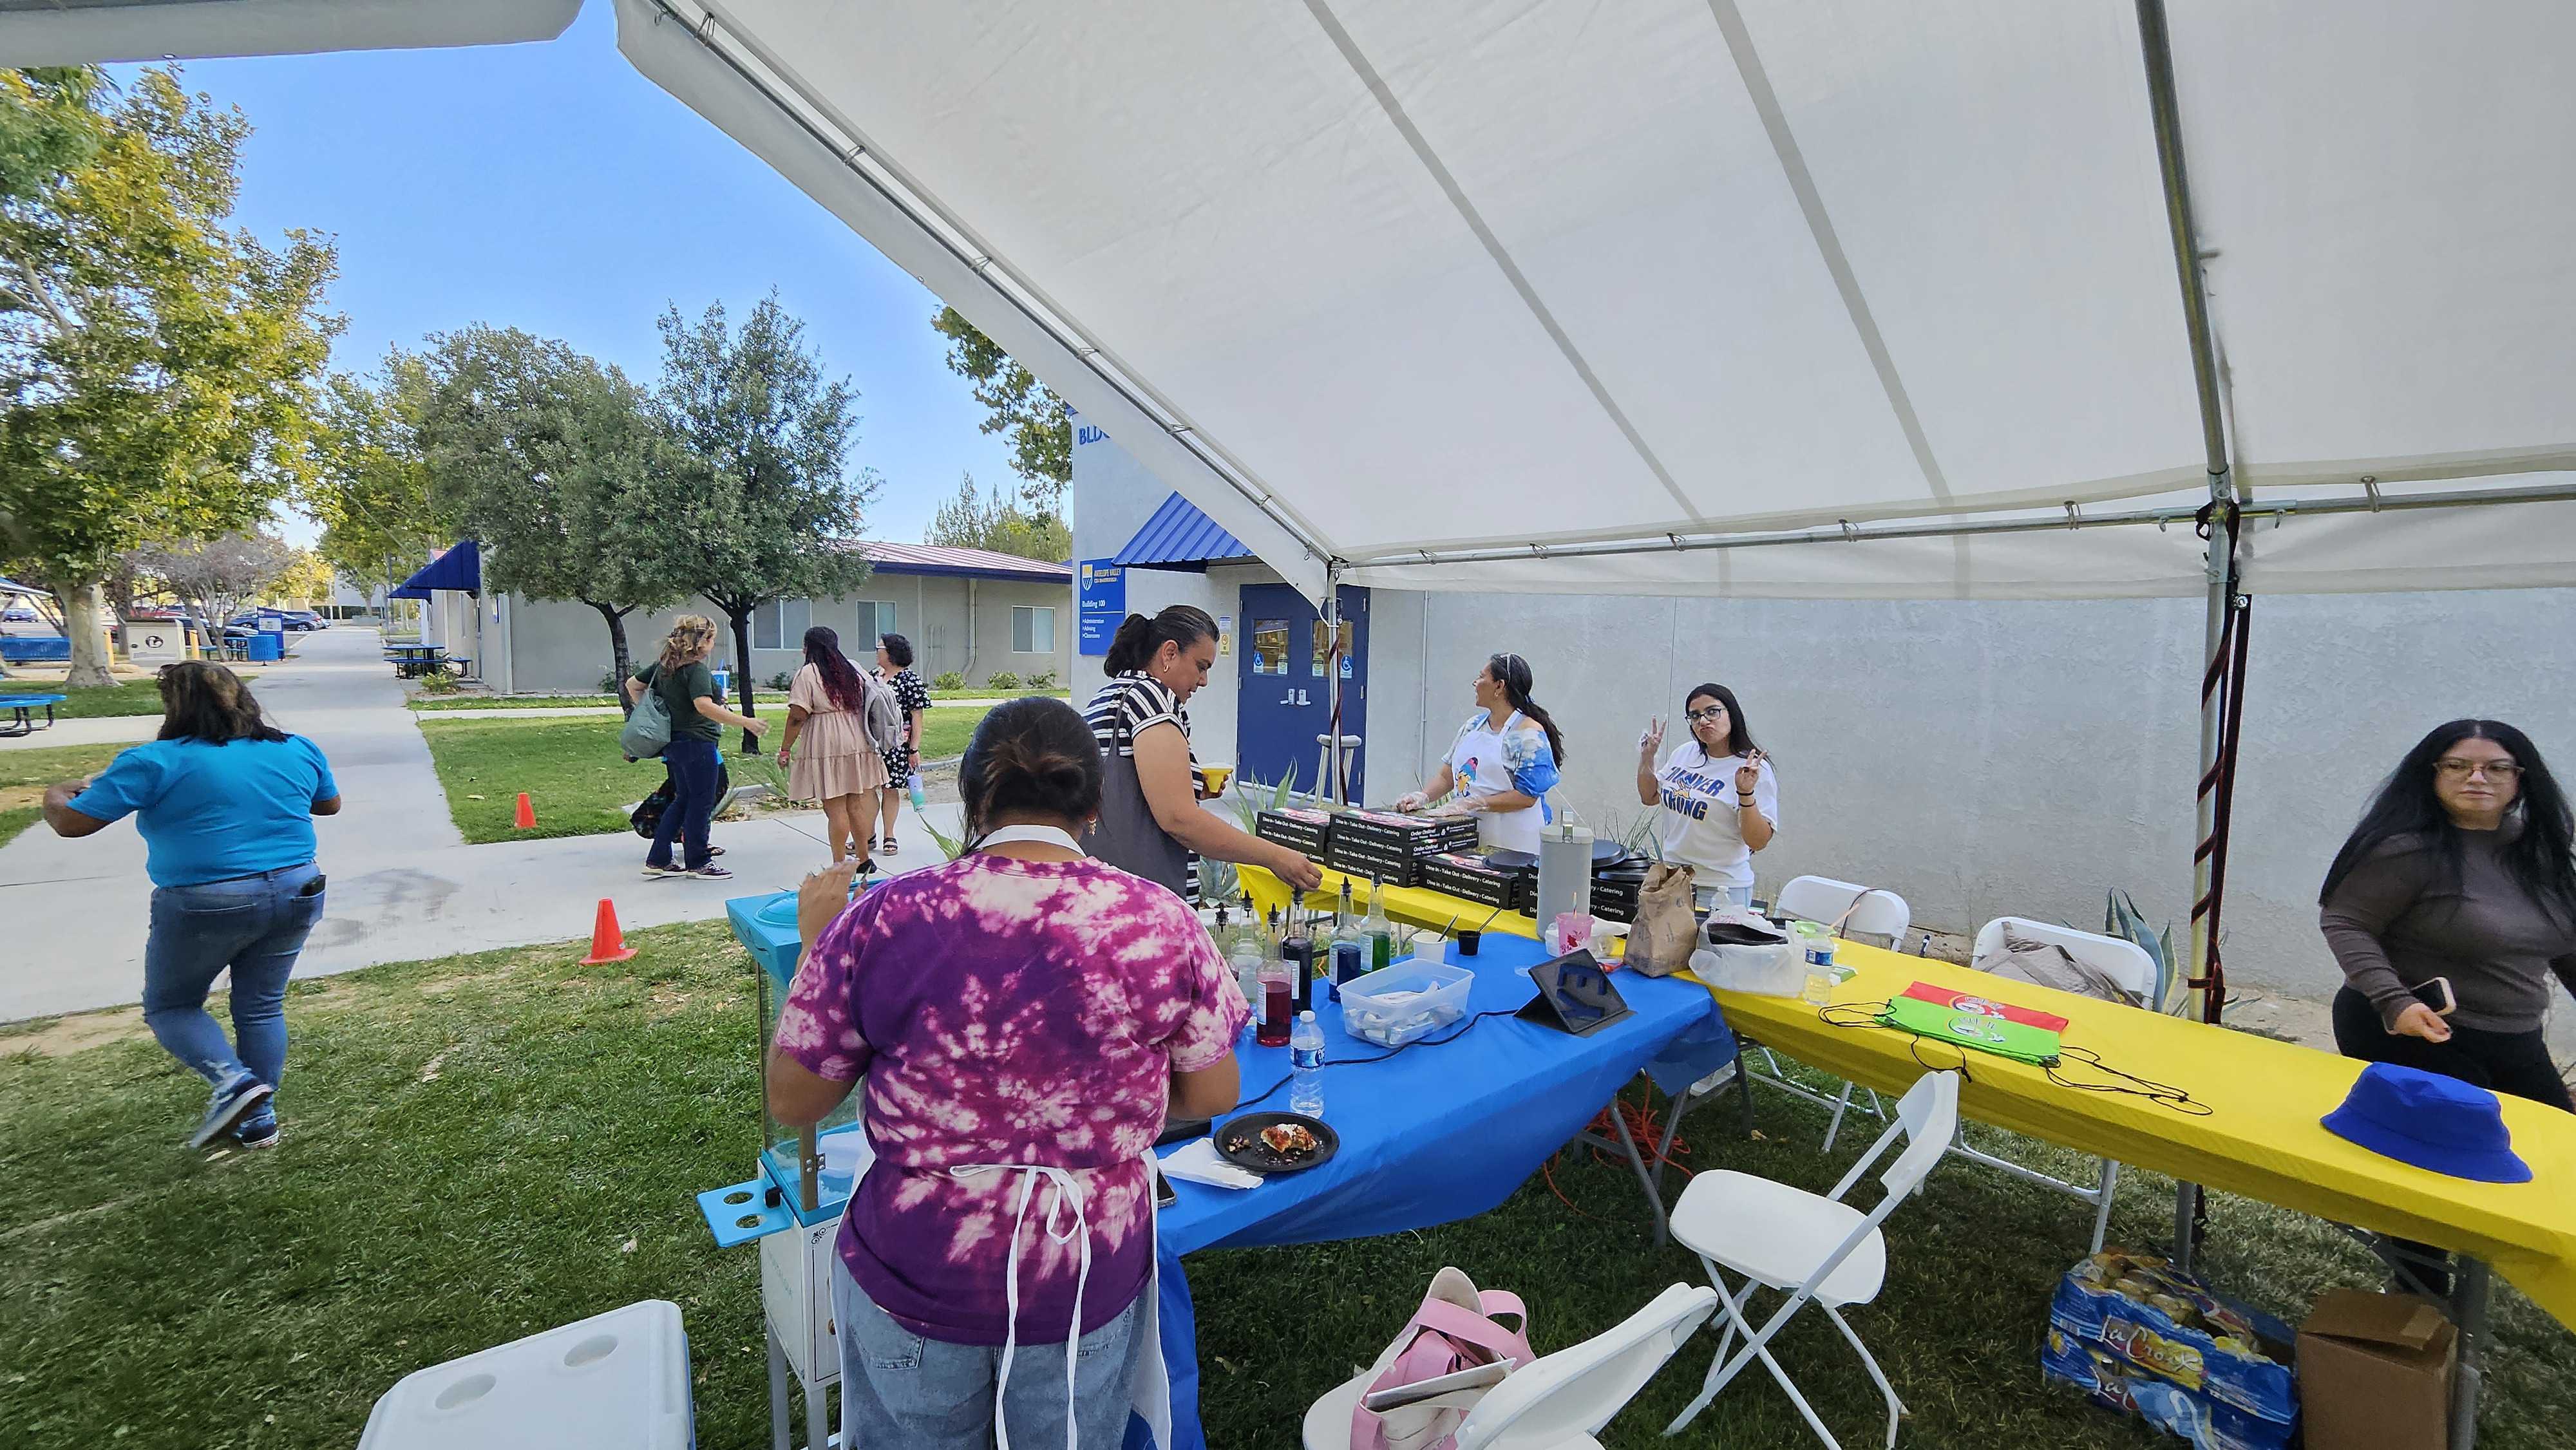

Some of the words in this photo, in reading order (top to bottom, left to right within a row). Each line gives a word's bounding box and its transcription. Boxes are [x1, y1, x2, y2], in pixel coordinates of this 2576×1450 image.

[1079, 425, 1110, 445] BLD
[1661, 788, 1707, 820] TRONG
[1384, 828, 1399, 837] Catering
[1386, 844, 1403, 853] Catering
[1367, 855, 1383, 863] Delivery
[1385, 860, 1401, 868] Catering
[1382, 874, 1399, 882] Catering
[1462, 873, 1479, 883] Delivery
[1482, 878, 1501, 887] Catering
[1462, 888, 1479, 898] Delivery
[1481, 893, 1499, 903] Catering
[1600, 886, 1624, 896] Catering
[1600, 905, 1624, 916] Catering
